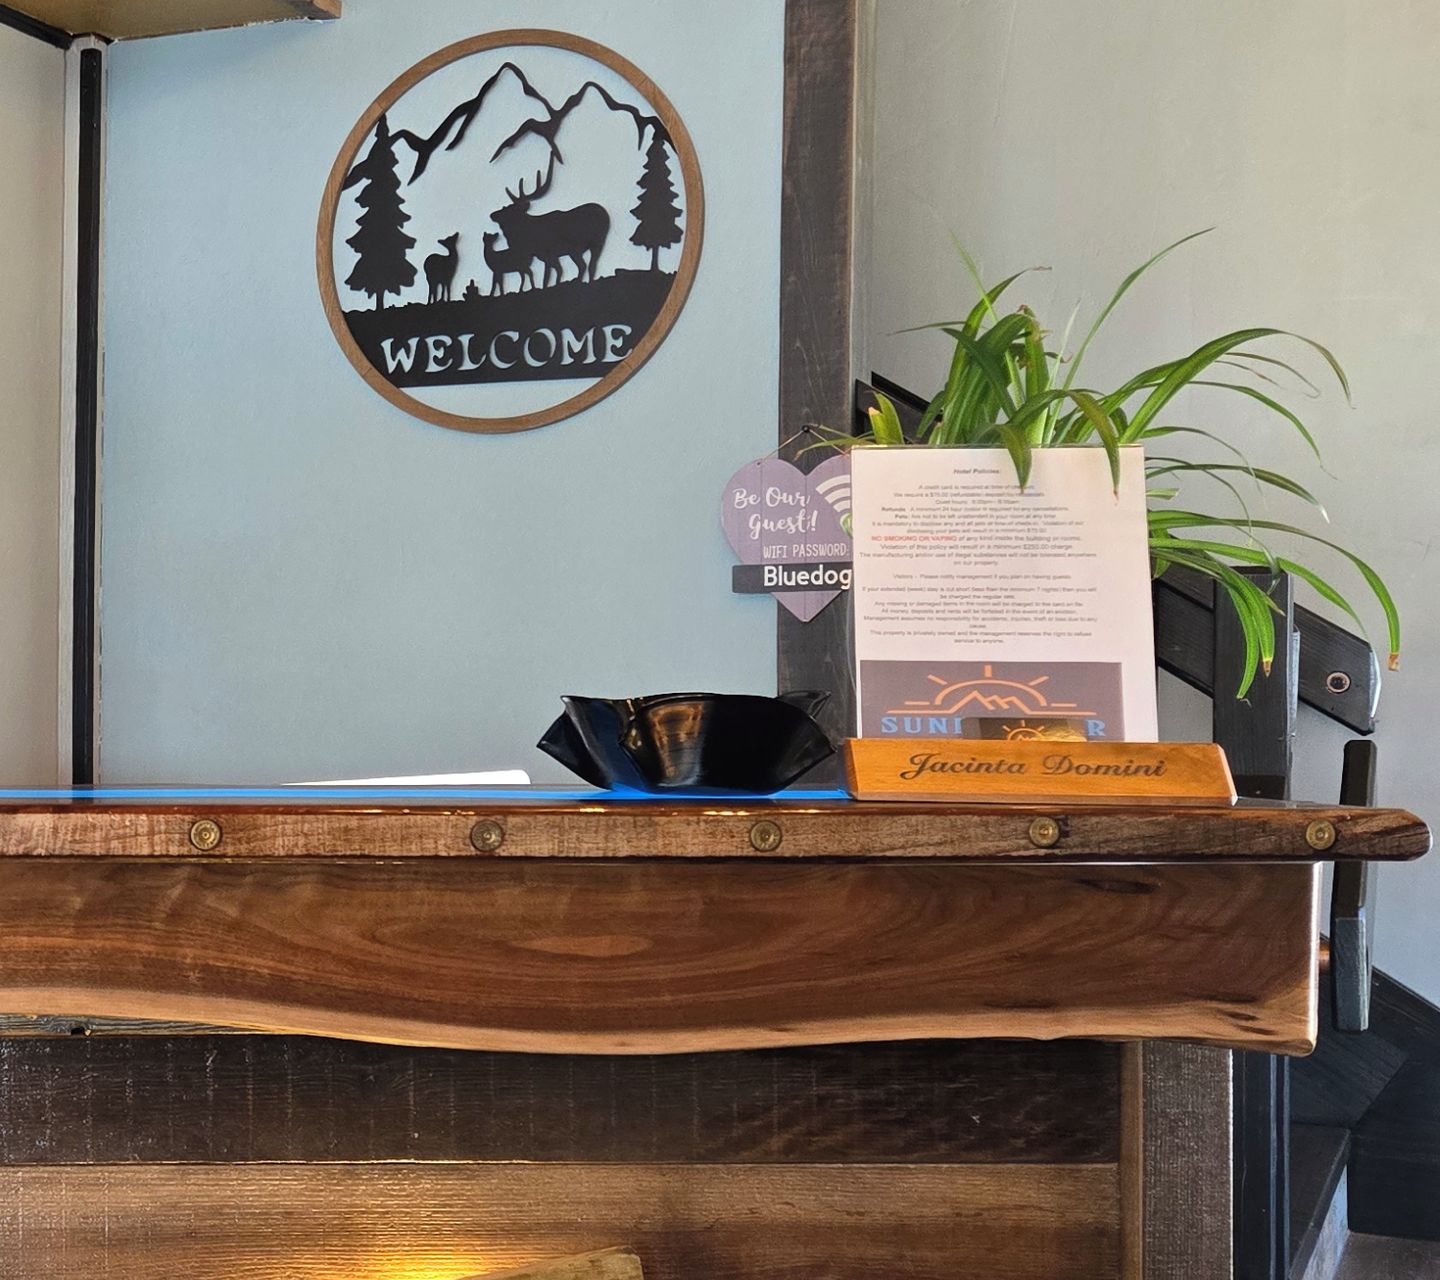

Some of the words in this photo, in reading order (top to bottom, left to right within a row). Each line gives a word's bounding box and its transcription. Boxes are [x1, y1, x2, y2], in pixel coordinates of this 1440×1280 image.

[379, 324, 634, 375] WELCOME
[732, 487, 761, 509] Be
[765, 486, 811, 508] Our
[763, 545, 788, 559] WIFI
[792, 543, 850, 558] PASSWORD:
[763, 564, 852, 590] Bluedog
[899, 752, 1026, 780] Jacinta
[1041, 754, 1168, 779] Domini
